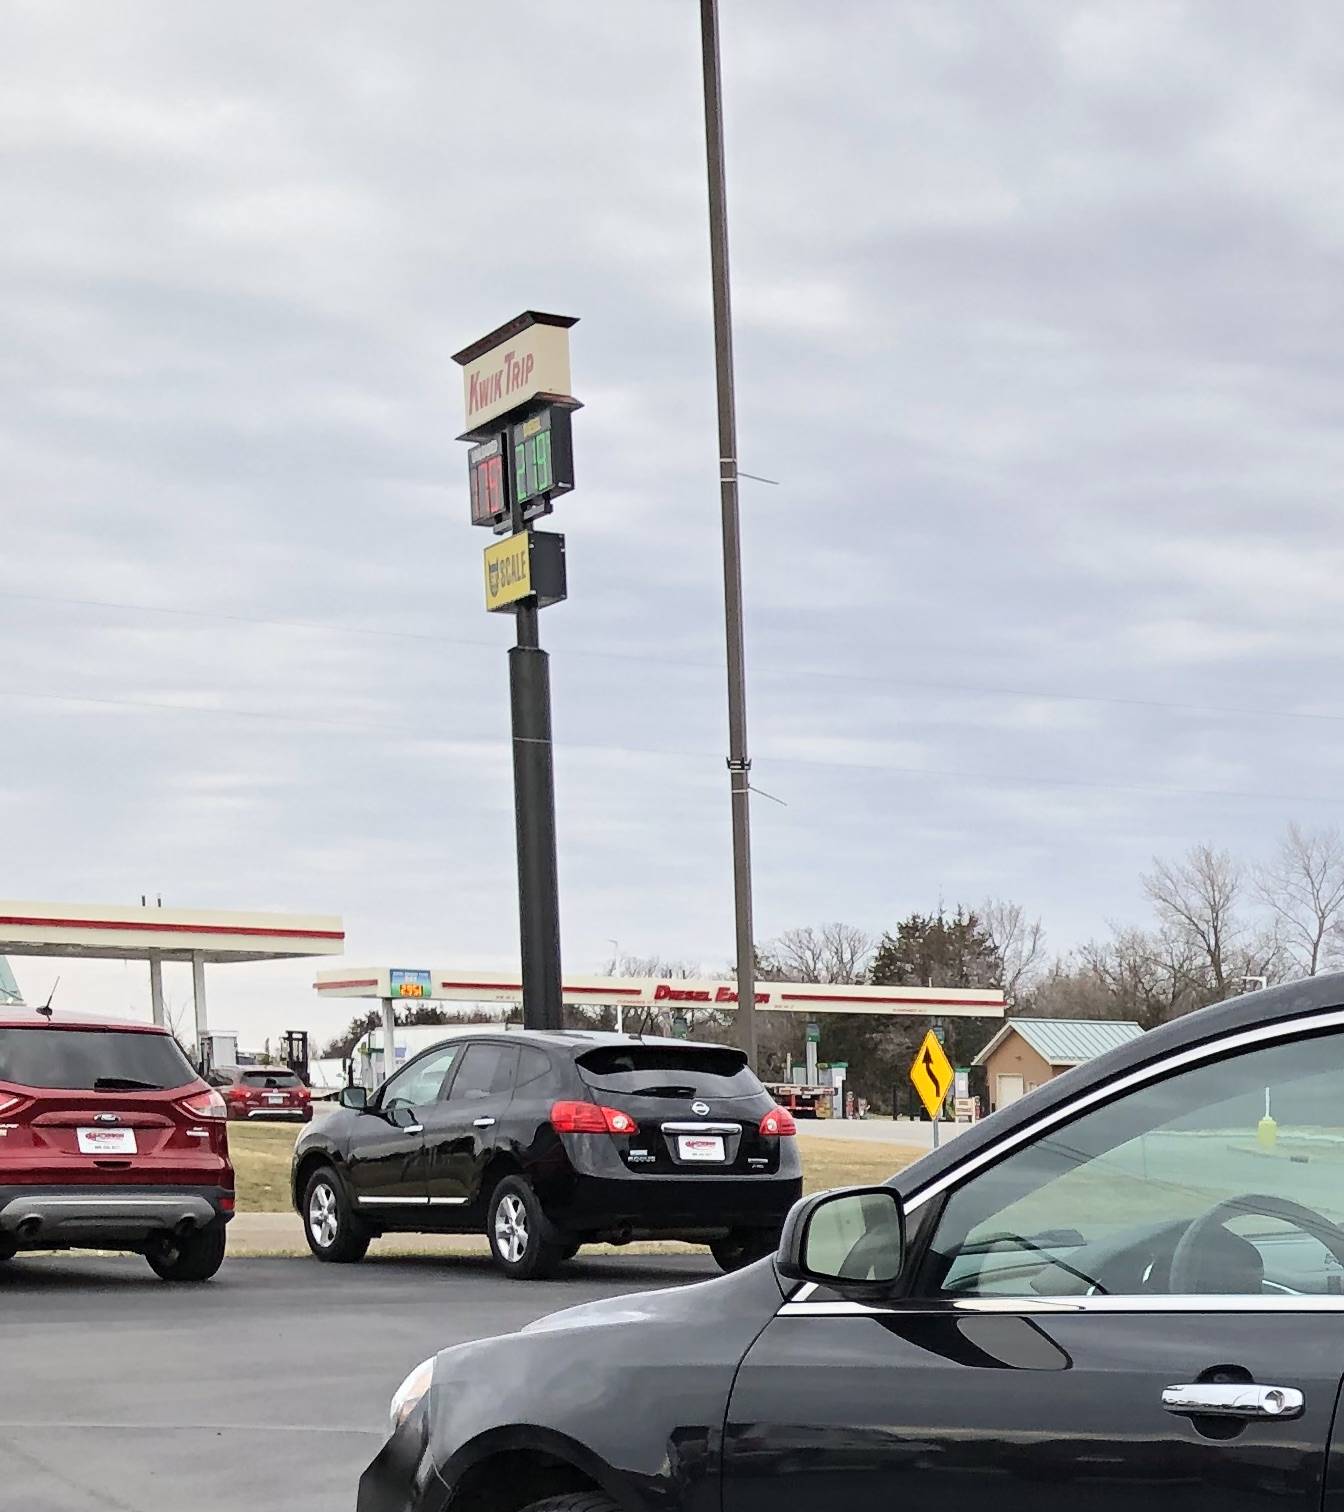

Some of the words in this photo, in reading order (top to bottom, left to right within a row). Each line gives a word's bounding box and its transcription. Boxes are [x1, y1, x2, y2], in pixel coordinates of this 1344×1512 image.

[469, 370, 503, 416] KWIK
[504, 350, 534, 395] TRIP
[500, 551, 527, 588] SCALE
